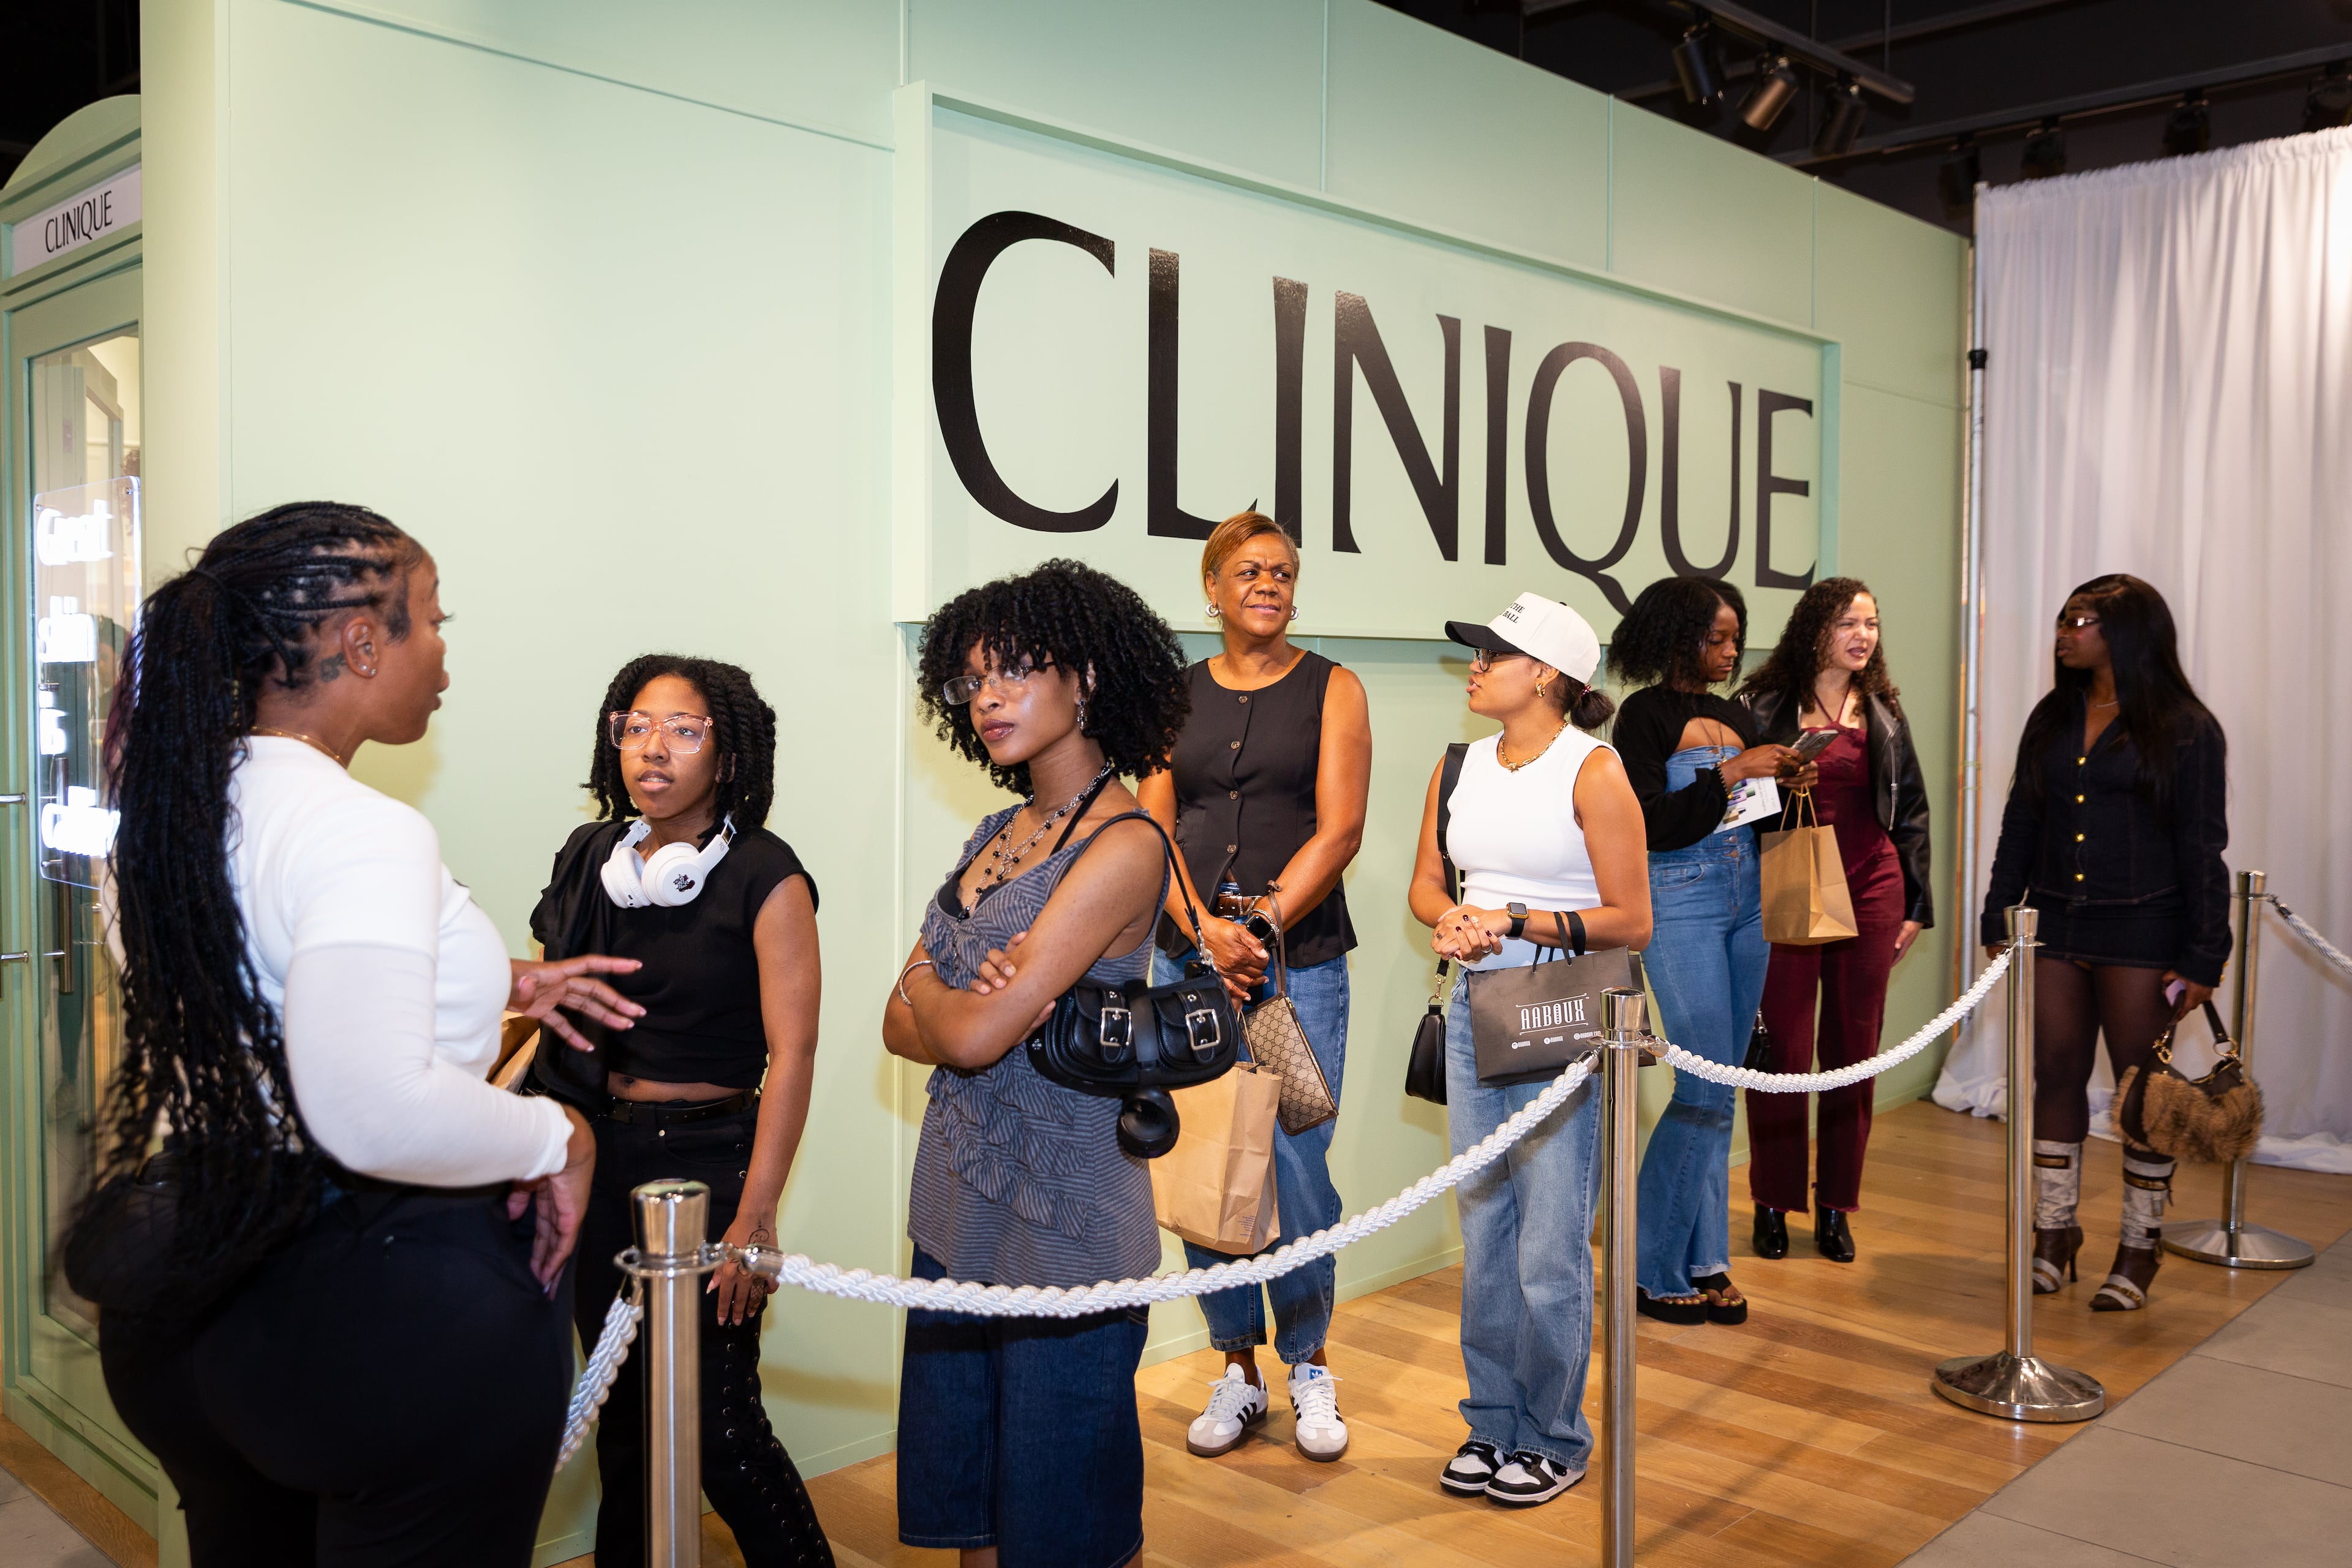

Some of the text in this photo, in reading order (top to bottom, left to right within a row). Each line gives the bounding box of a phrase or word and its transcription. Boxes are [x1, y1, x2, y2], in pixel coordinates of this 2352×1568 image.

[45, 190, 113, 253] CLINIQUE
[932, 210, 1814, 615] CLINIQUE
[1502, 611, 1519, 624] BALL
[1510, 603, 1525, 614] THE
[1521, 999, 1585, 1030] AABOUX
